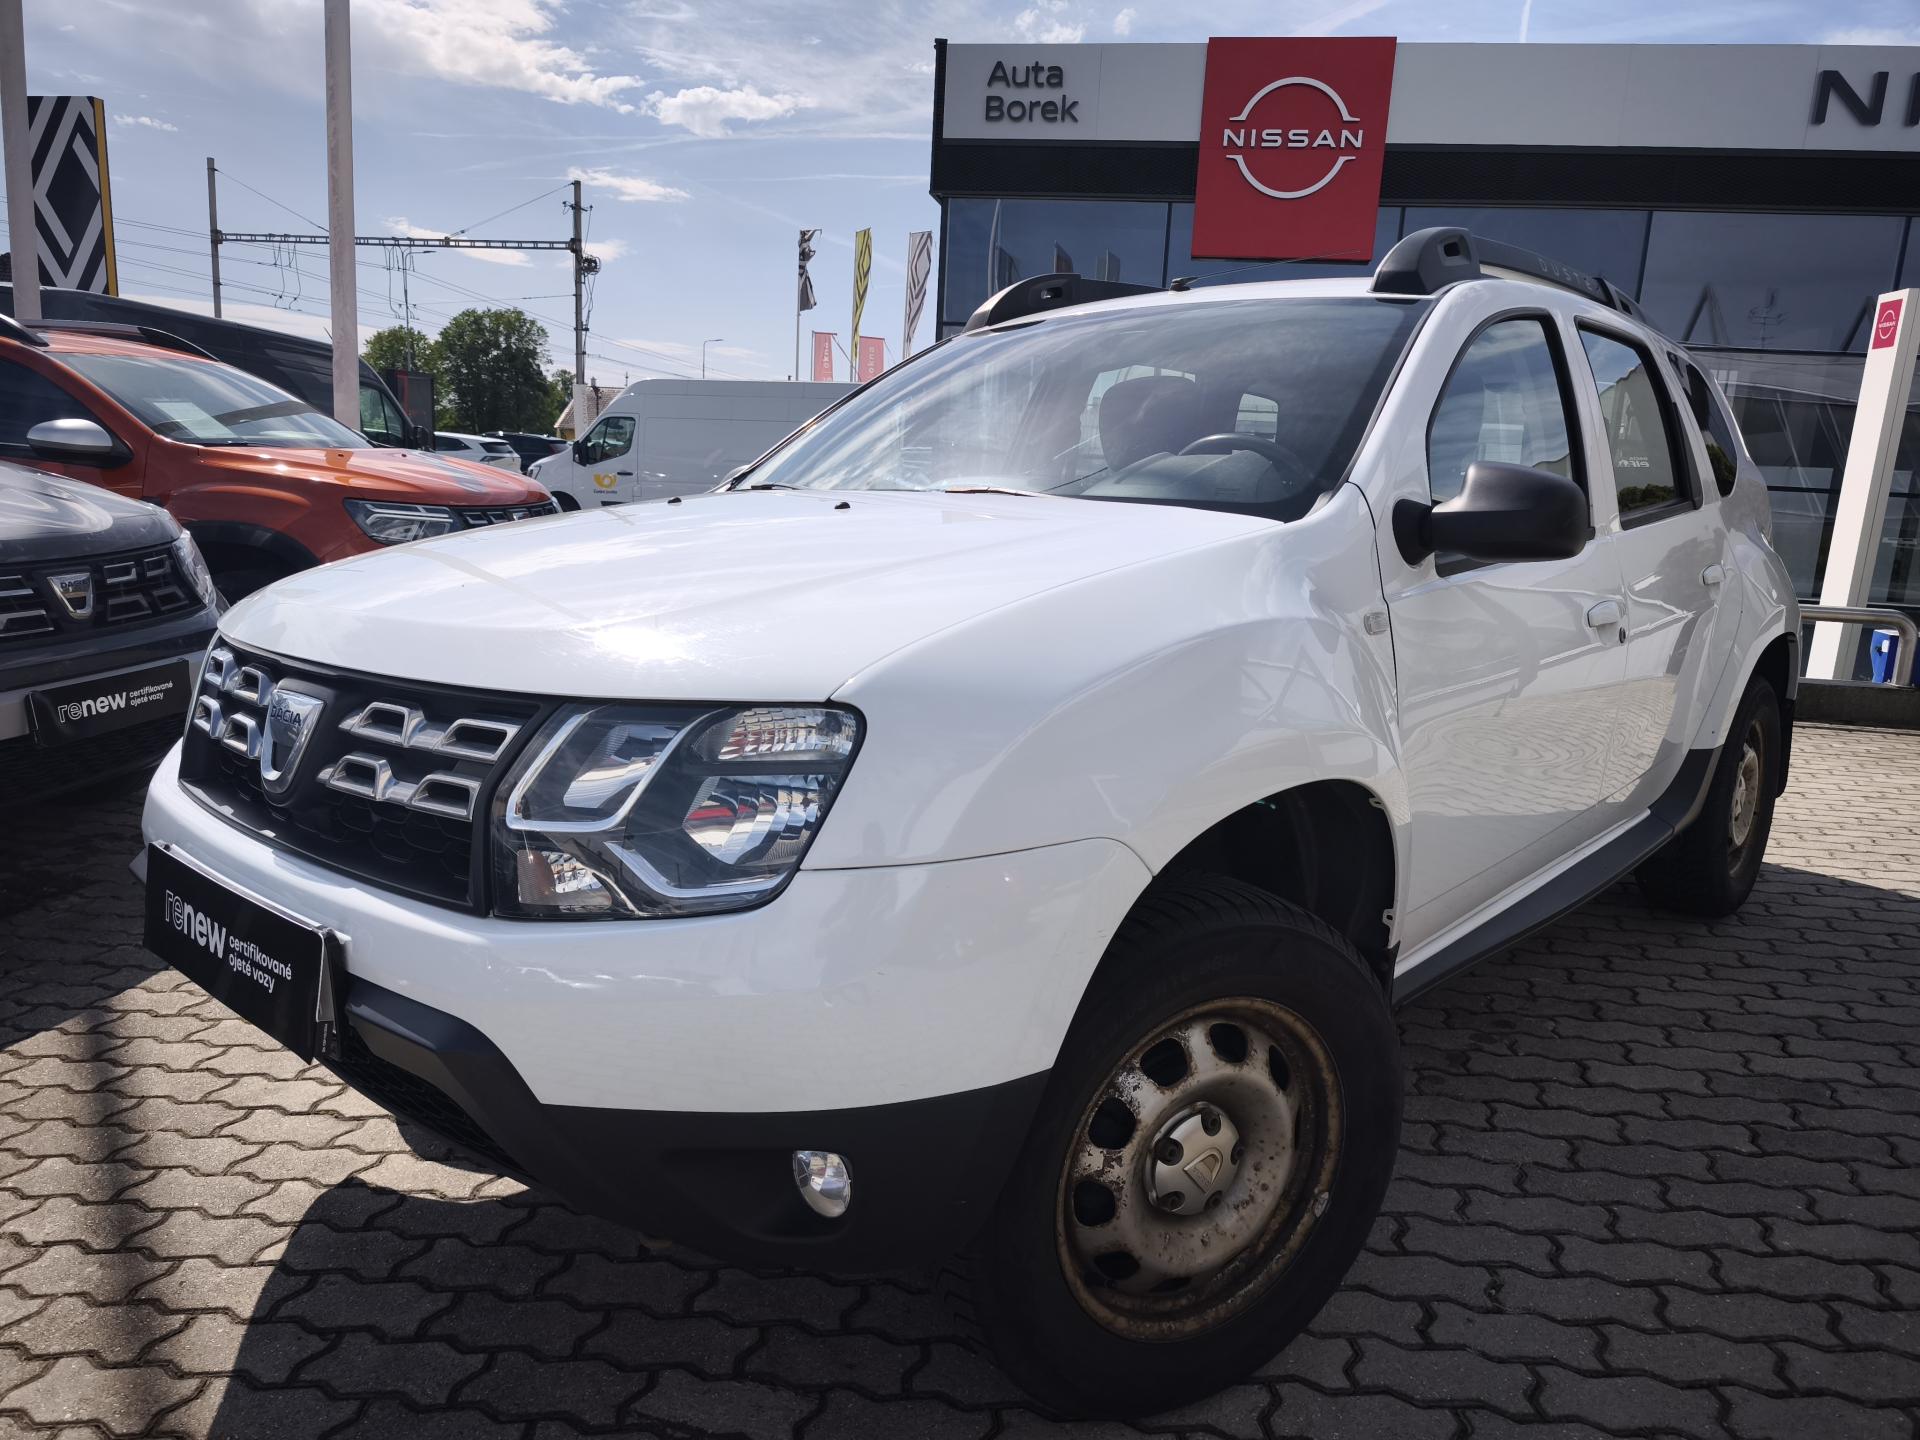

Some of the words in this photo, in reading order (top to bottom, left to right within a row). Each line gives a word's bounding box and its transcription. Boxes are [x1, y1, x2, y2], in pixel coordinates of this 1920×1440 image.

[987, 60, 1064, 88] Auta
[985, 94, 1079, 123] Borek
[1223, 128, 1363, 148] NISSAN
[129, 681, 173, 698] certifikované
[130, 695, 149, 707] ojeté
[148, 692, 164, 702] vozy
[58, 692, 126, 723] renew
[270, 706, 302, 726] DACIA
[166, 890, 226, 959] renew
[229, 935, 292, 980] certifikované
[229, 953, 251, 976] ojeté
[252, 968, 275, 993] vozy
